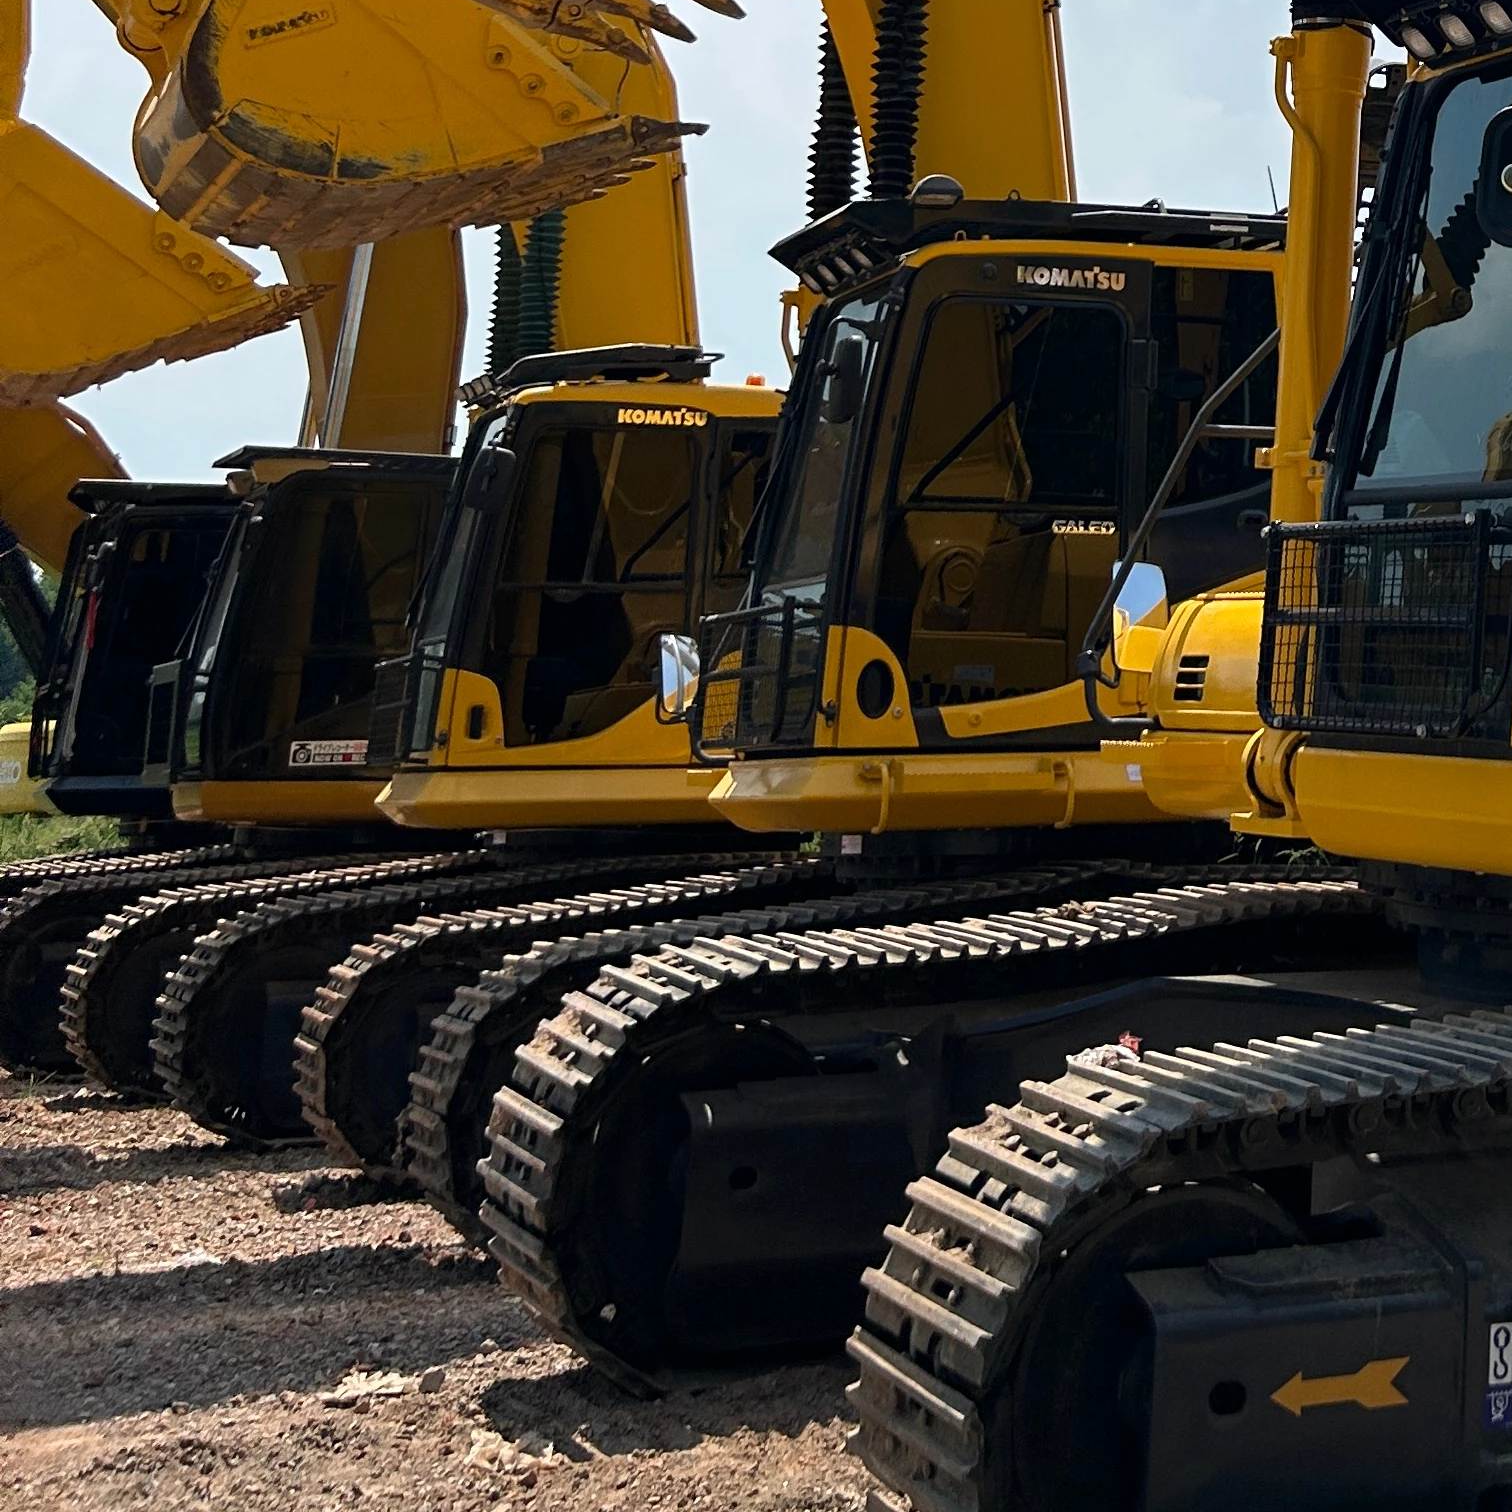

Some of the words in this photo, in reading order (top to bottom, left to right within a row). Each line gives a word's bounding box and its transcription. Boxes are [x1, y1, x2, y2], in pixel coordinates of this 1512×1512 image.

[1017, 265, 1126, 291] KOMATSU
[617, 407, 708, 427] KOMATSU
[1051, 519, 1116, 535] GALEO
